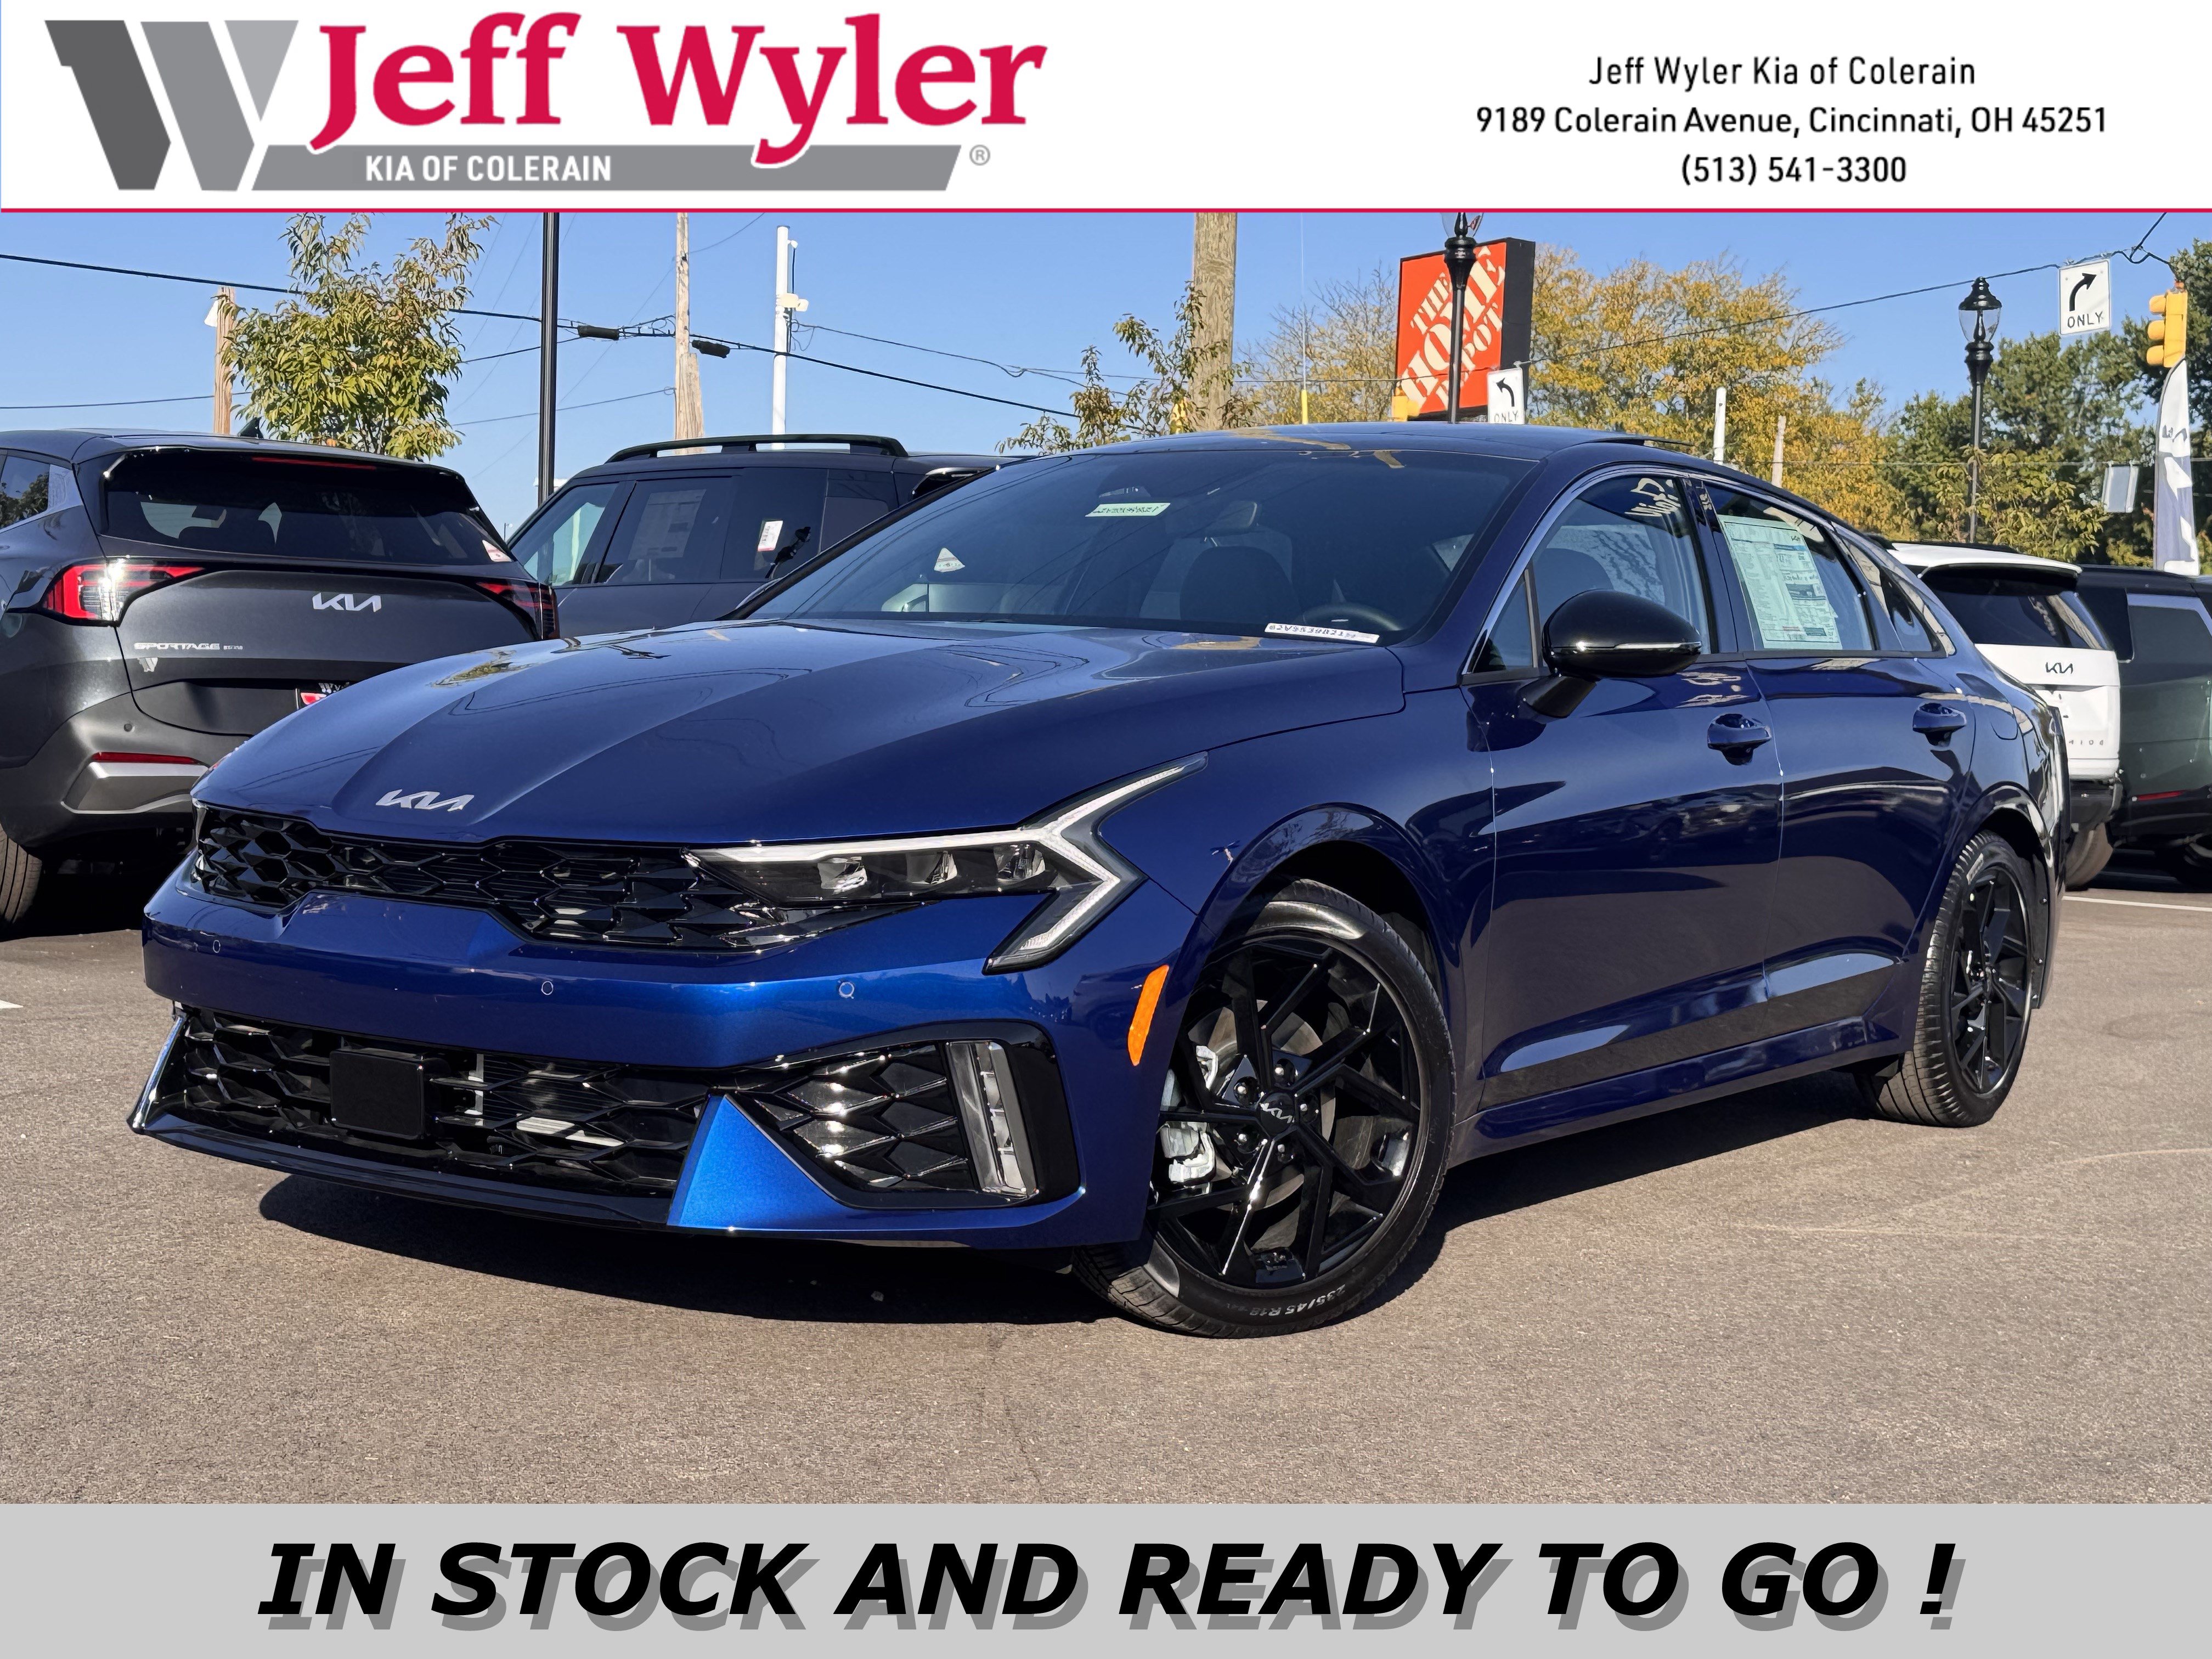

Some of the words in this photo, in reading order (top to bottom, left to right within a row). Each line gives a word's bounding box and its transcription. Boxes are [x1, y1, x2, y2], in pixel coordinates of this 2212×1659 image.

[2067, 311, 2104, 329] ONLY
[1435, 302, 1503, 410] DPOT
[1493, 409, 1519, 424] ONLY
[312, 592, 382, 613] KIA
[2045, 662, 2074, 674] KIA
[375, 788, 475, 812] KIA
